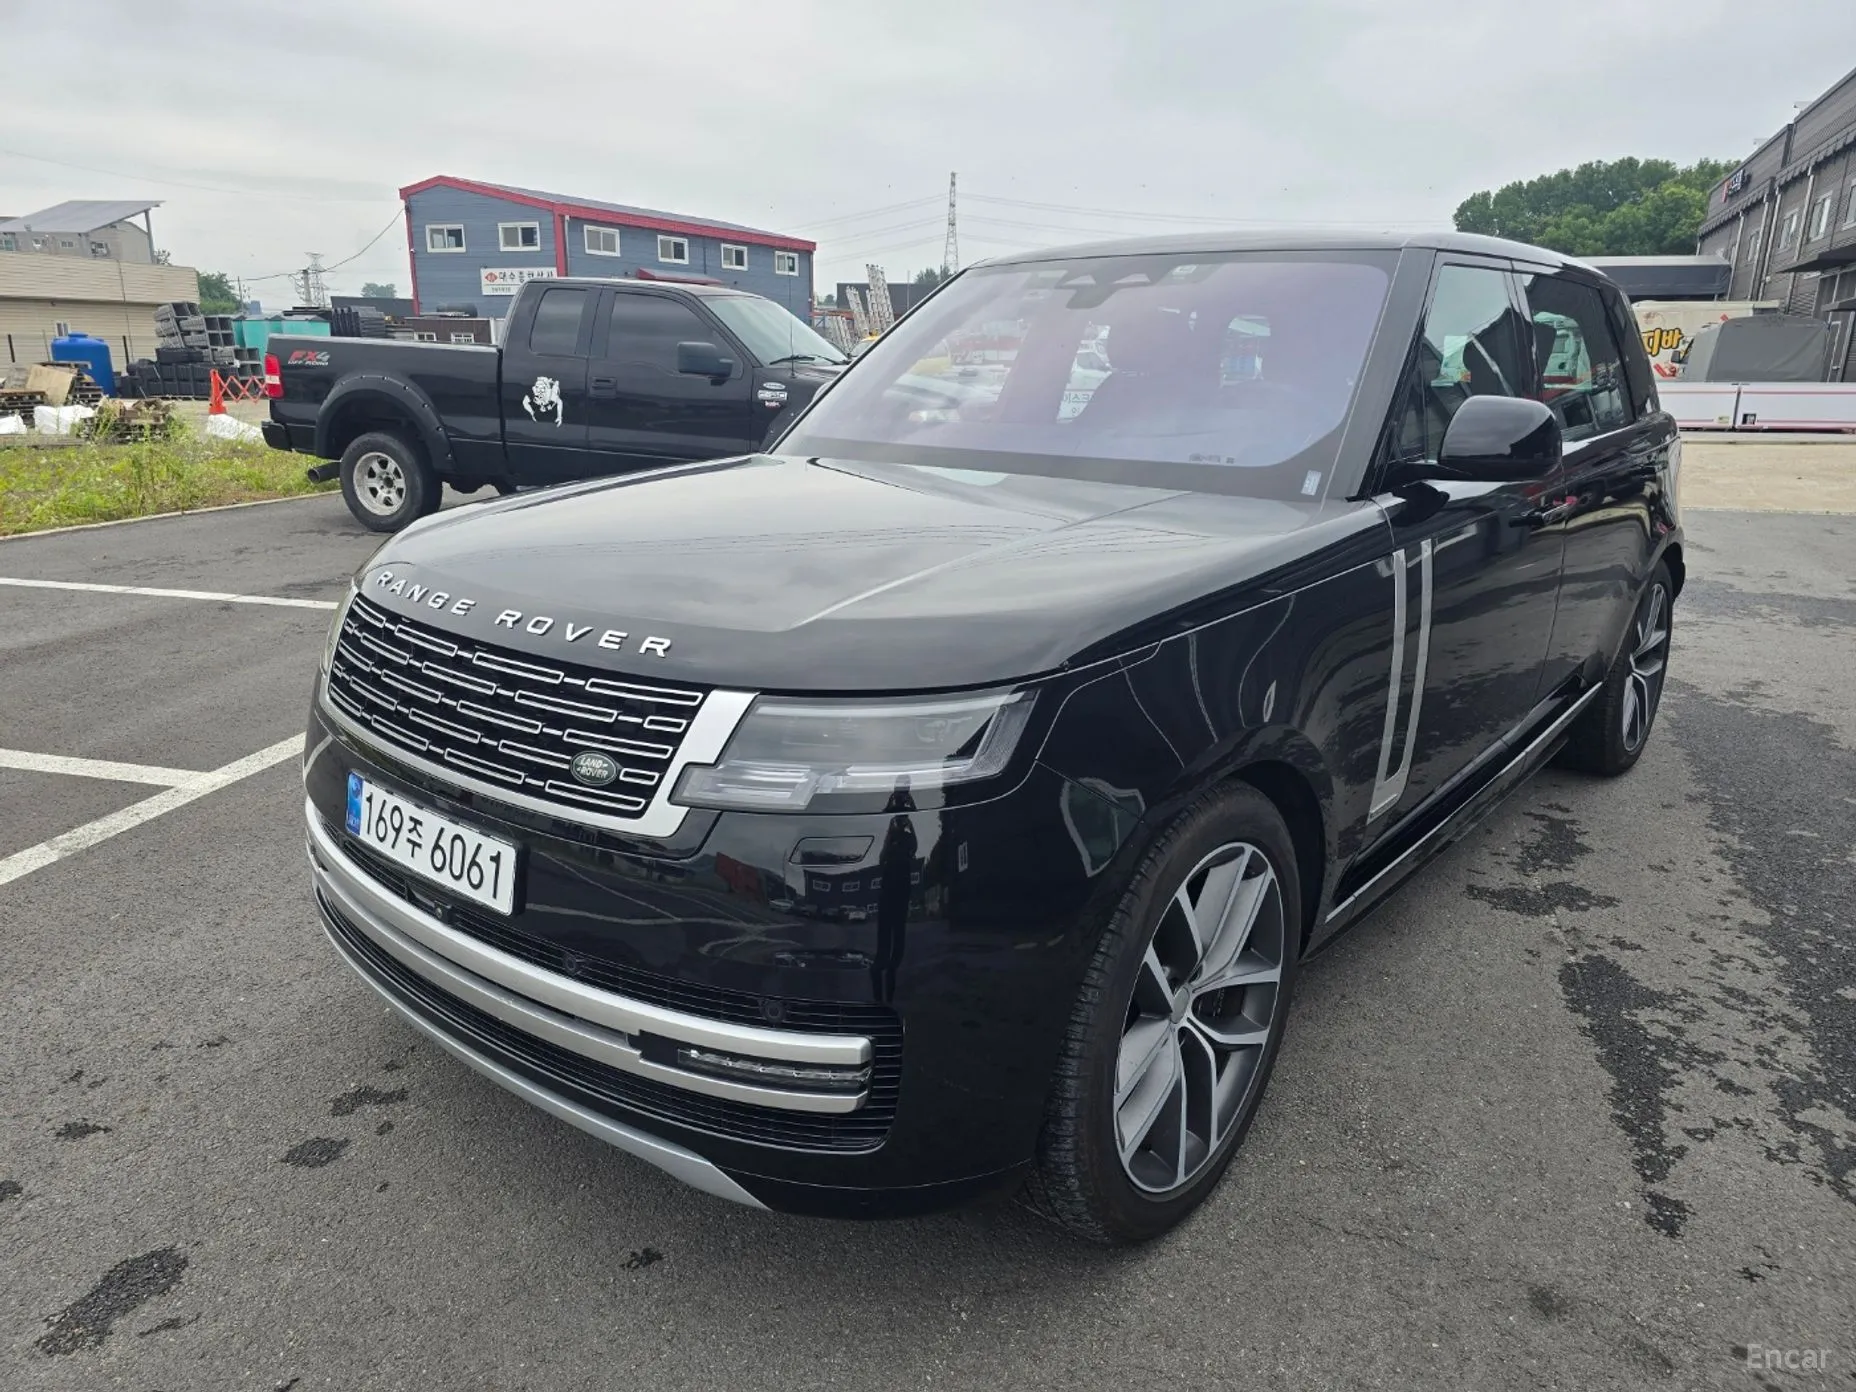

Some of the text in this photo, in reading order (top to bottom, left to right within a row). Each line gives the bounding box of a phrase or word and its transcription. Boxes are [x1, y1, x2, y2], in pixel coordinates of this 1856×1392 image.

[288, 351, 331, 362] FX4
[376, 570, 672, 658] RANGE ROVER
[580, 756, 604, 769] LAND
[580, 766, 609, 779] ROVER
[365, 791, 502, 900] 169주 6061
